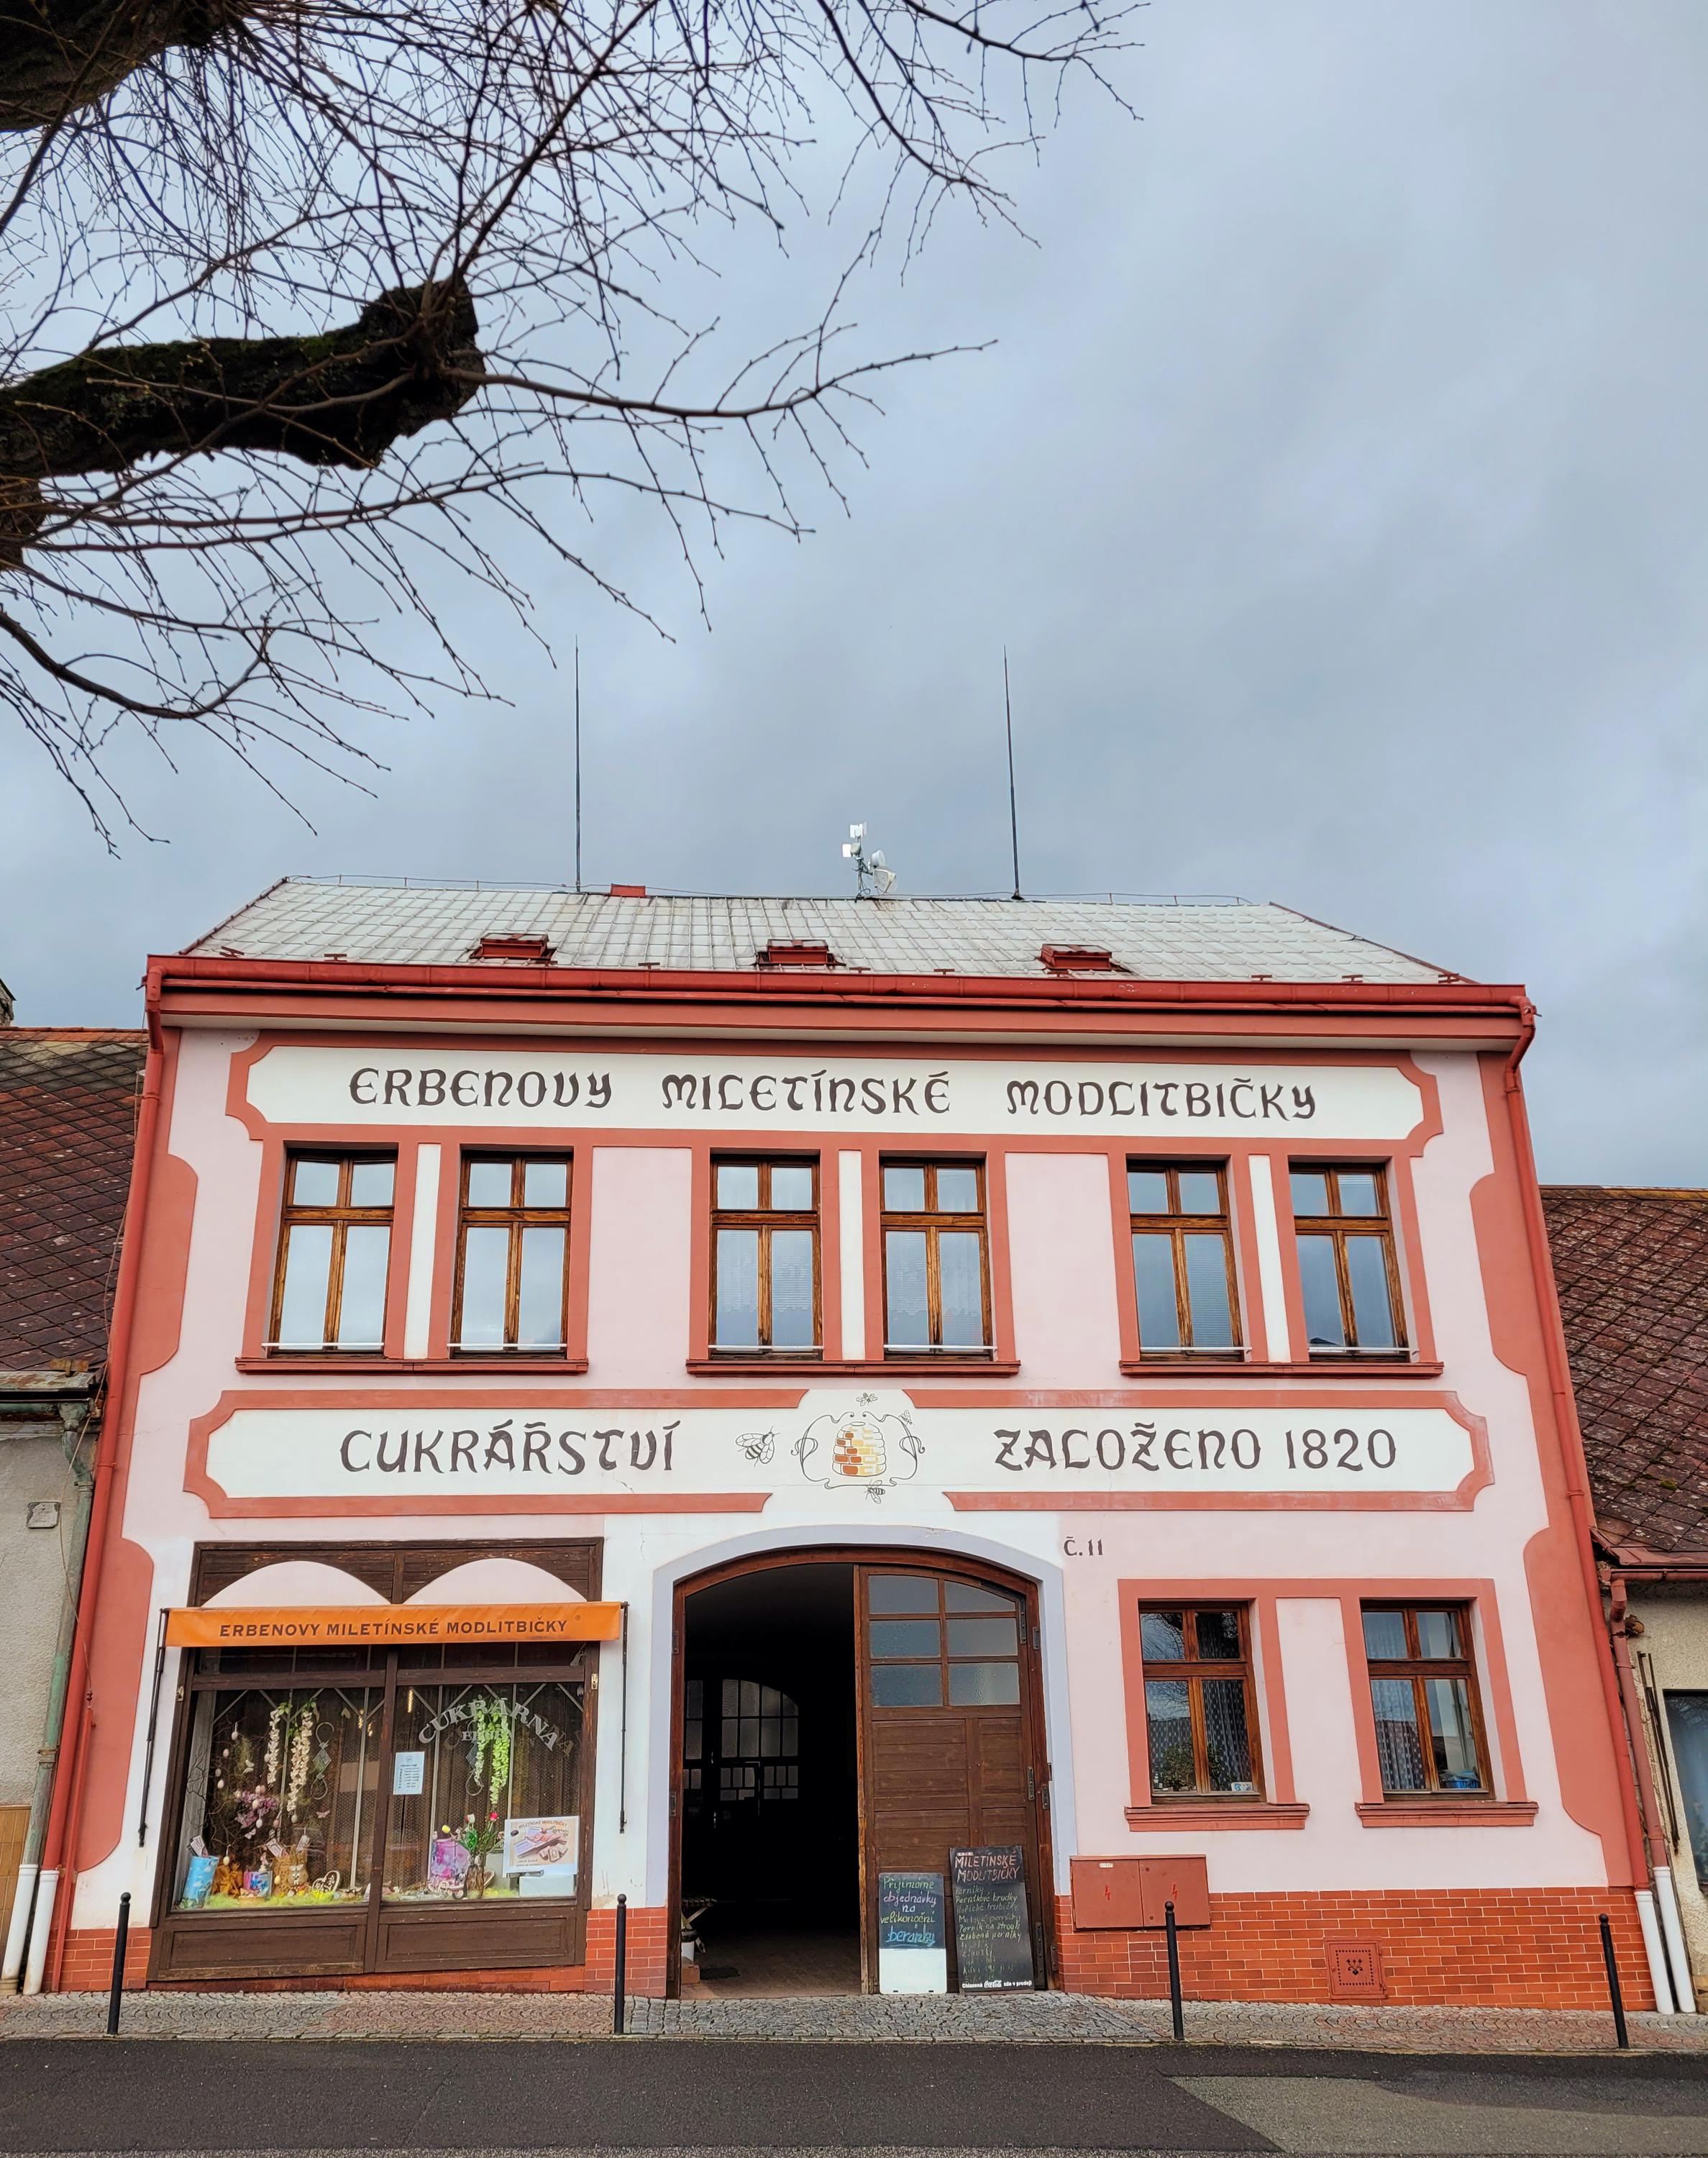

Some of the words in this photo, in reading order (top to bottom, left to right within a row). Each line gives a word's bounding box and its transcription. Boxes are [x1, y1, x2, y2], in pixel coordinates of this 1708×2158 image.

[349, 1067, 612, 1108] ERBENOVY
[662, 1070, 949, 1115] MILETÍNSKÉ
[1007, 1078, 1316, 1121] MODLITBIČKY
[339, 1419, 681, 1475] CUKRÁŘSTVÍ
[992, 1422, 1261, 1472] ZALOŽENO
[1285, 1429, 1396, 1472] 1820
[219, 1624, 320, 1637] ERBENOVY
[326, 1618, 439, 1636] MILETÍNSKÉ
[447, 1616, 568, 1634] MODLITBIČKY
[419, 1697, 560, 1752] CUKRÁRNA
[954, 1849, 1017, 1869] MILETÍNSKÉ
[883, 1890, 937, 1908] objednávky
[902, 1904, 915, 1913] na
[880, 1911, 936, 1923] velikonoční
